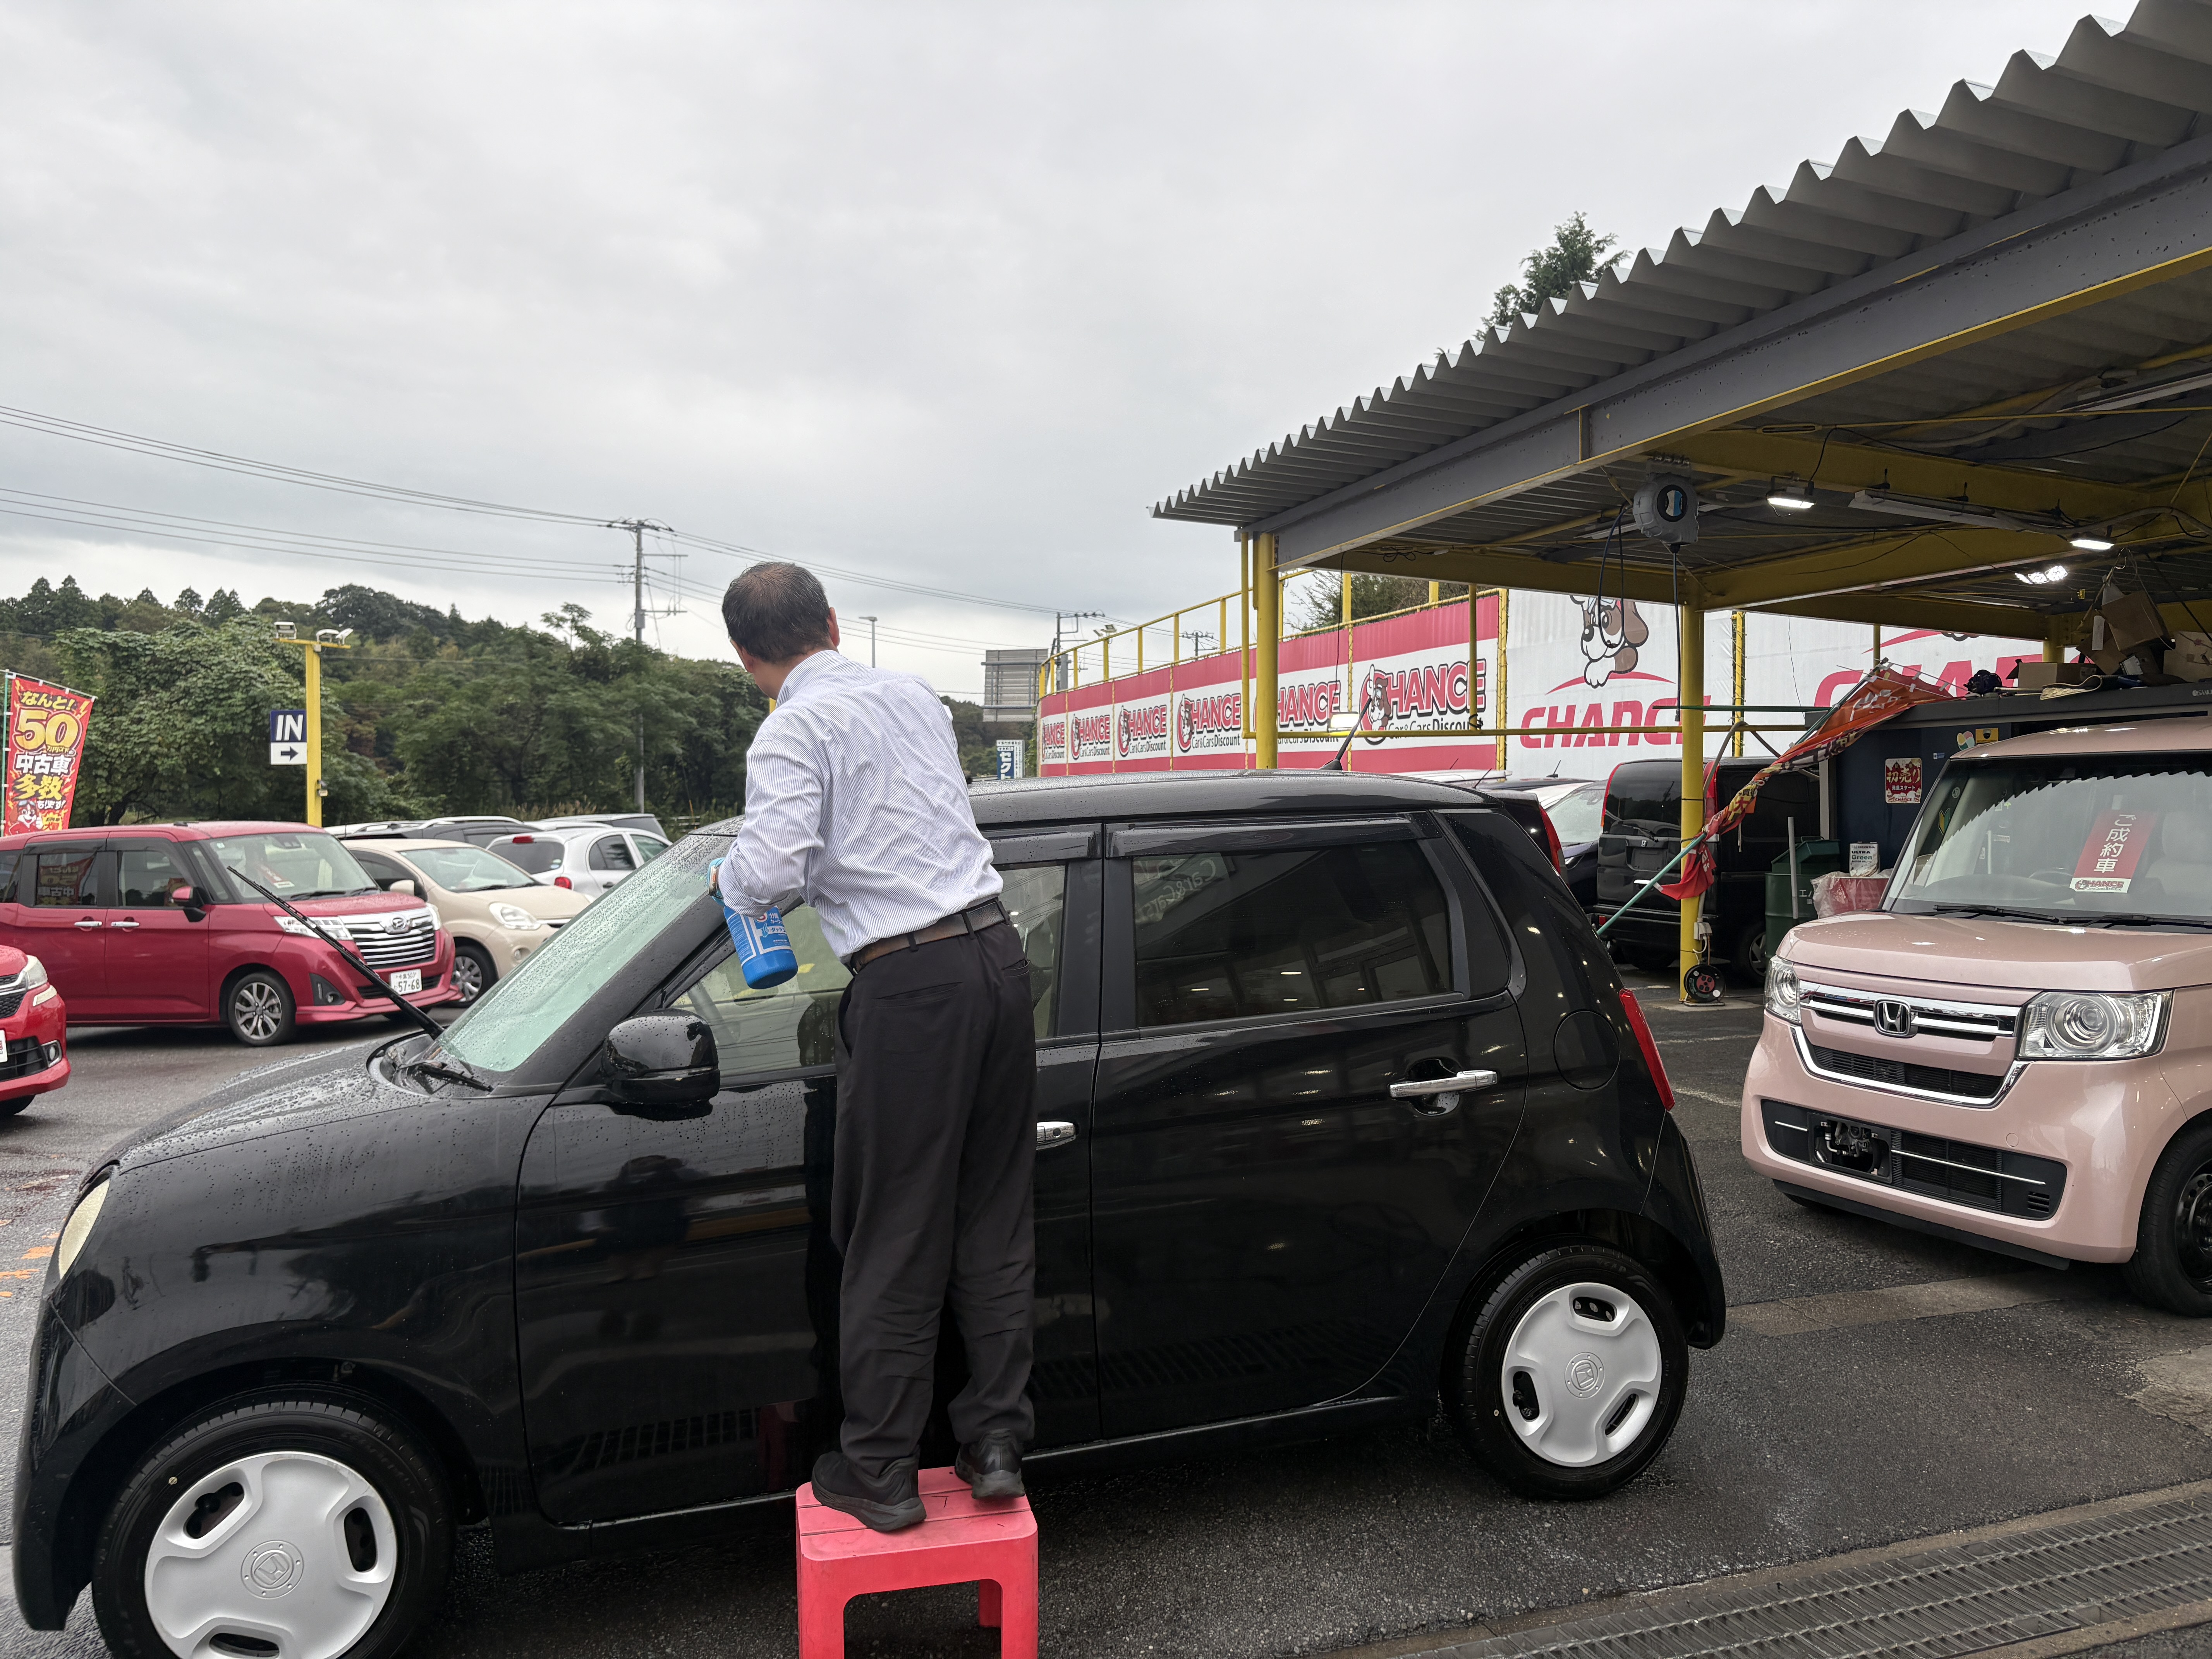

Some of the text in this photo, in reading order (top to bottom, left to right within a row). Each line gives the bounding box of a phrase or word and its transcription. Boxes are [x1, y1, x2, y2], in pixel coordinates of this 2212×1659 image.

[21, 691, 75, 711] なんと!
[1254, 680, 1341, 730] HANCE
[1359, 658, 1487, 745] CHANCE
[15, 709, 79, 750] 50
[276, 714, 303, 741] IN
[1117, 704, 1167, 756] CHANCE
[1177, 693, 1242, 752] CHANCE
[1071, 714, 1110, 760] CHANCE
[1146, 740, 1166, 752] Discount
[1214, 735, 1240, 747] Discount
[15, 752, 72, 775] 中古車
[1886, 767, 1920, 784] 初売り
[14, 774, 63, 800] 多数
[2094, 814, 2136, 873] ご成約車
[2075, 879, 2124, 890] CHANCE
